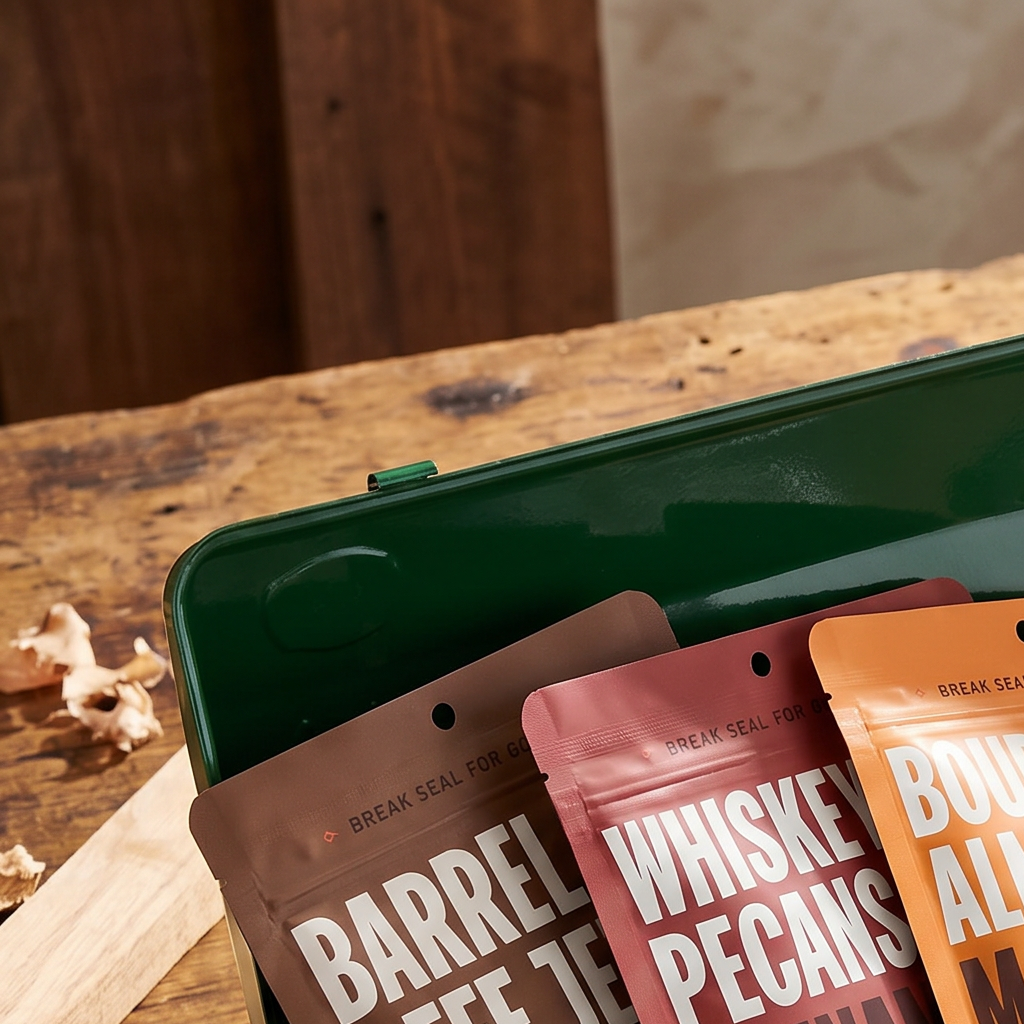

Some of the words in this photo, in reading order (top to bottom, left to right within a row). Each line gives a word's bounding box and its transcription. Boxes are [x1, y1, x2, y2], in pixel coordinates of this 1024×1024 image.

[937, 680, 991, 698] BREAK
[665, 727, 723, 756] BREAK
[726, 715, 769, 738] SEAL
[772, 704, 806, 725] FOR
[348, 792, 413, 834] BREAK
[415, 770, 463, 802] SEAL
[466, 750, 502, 777] FOR
